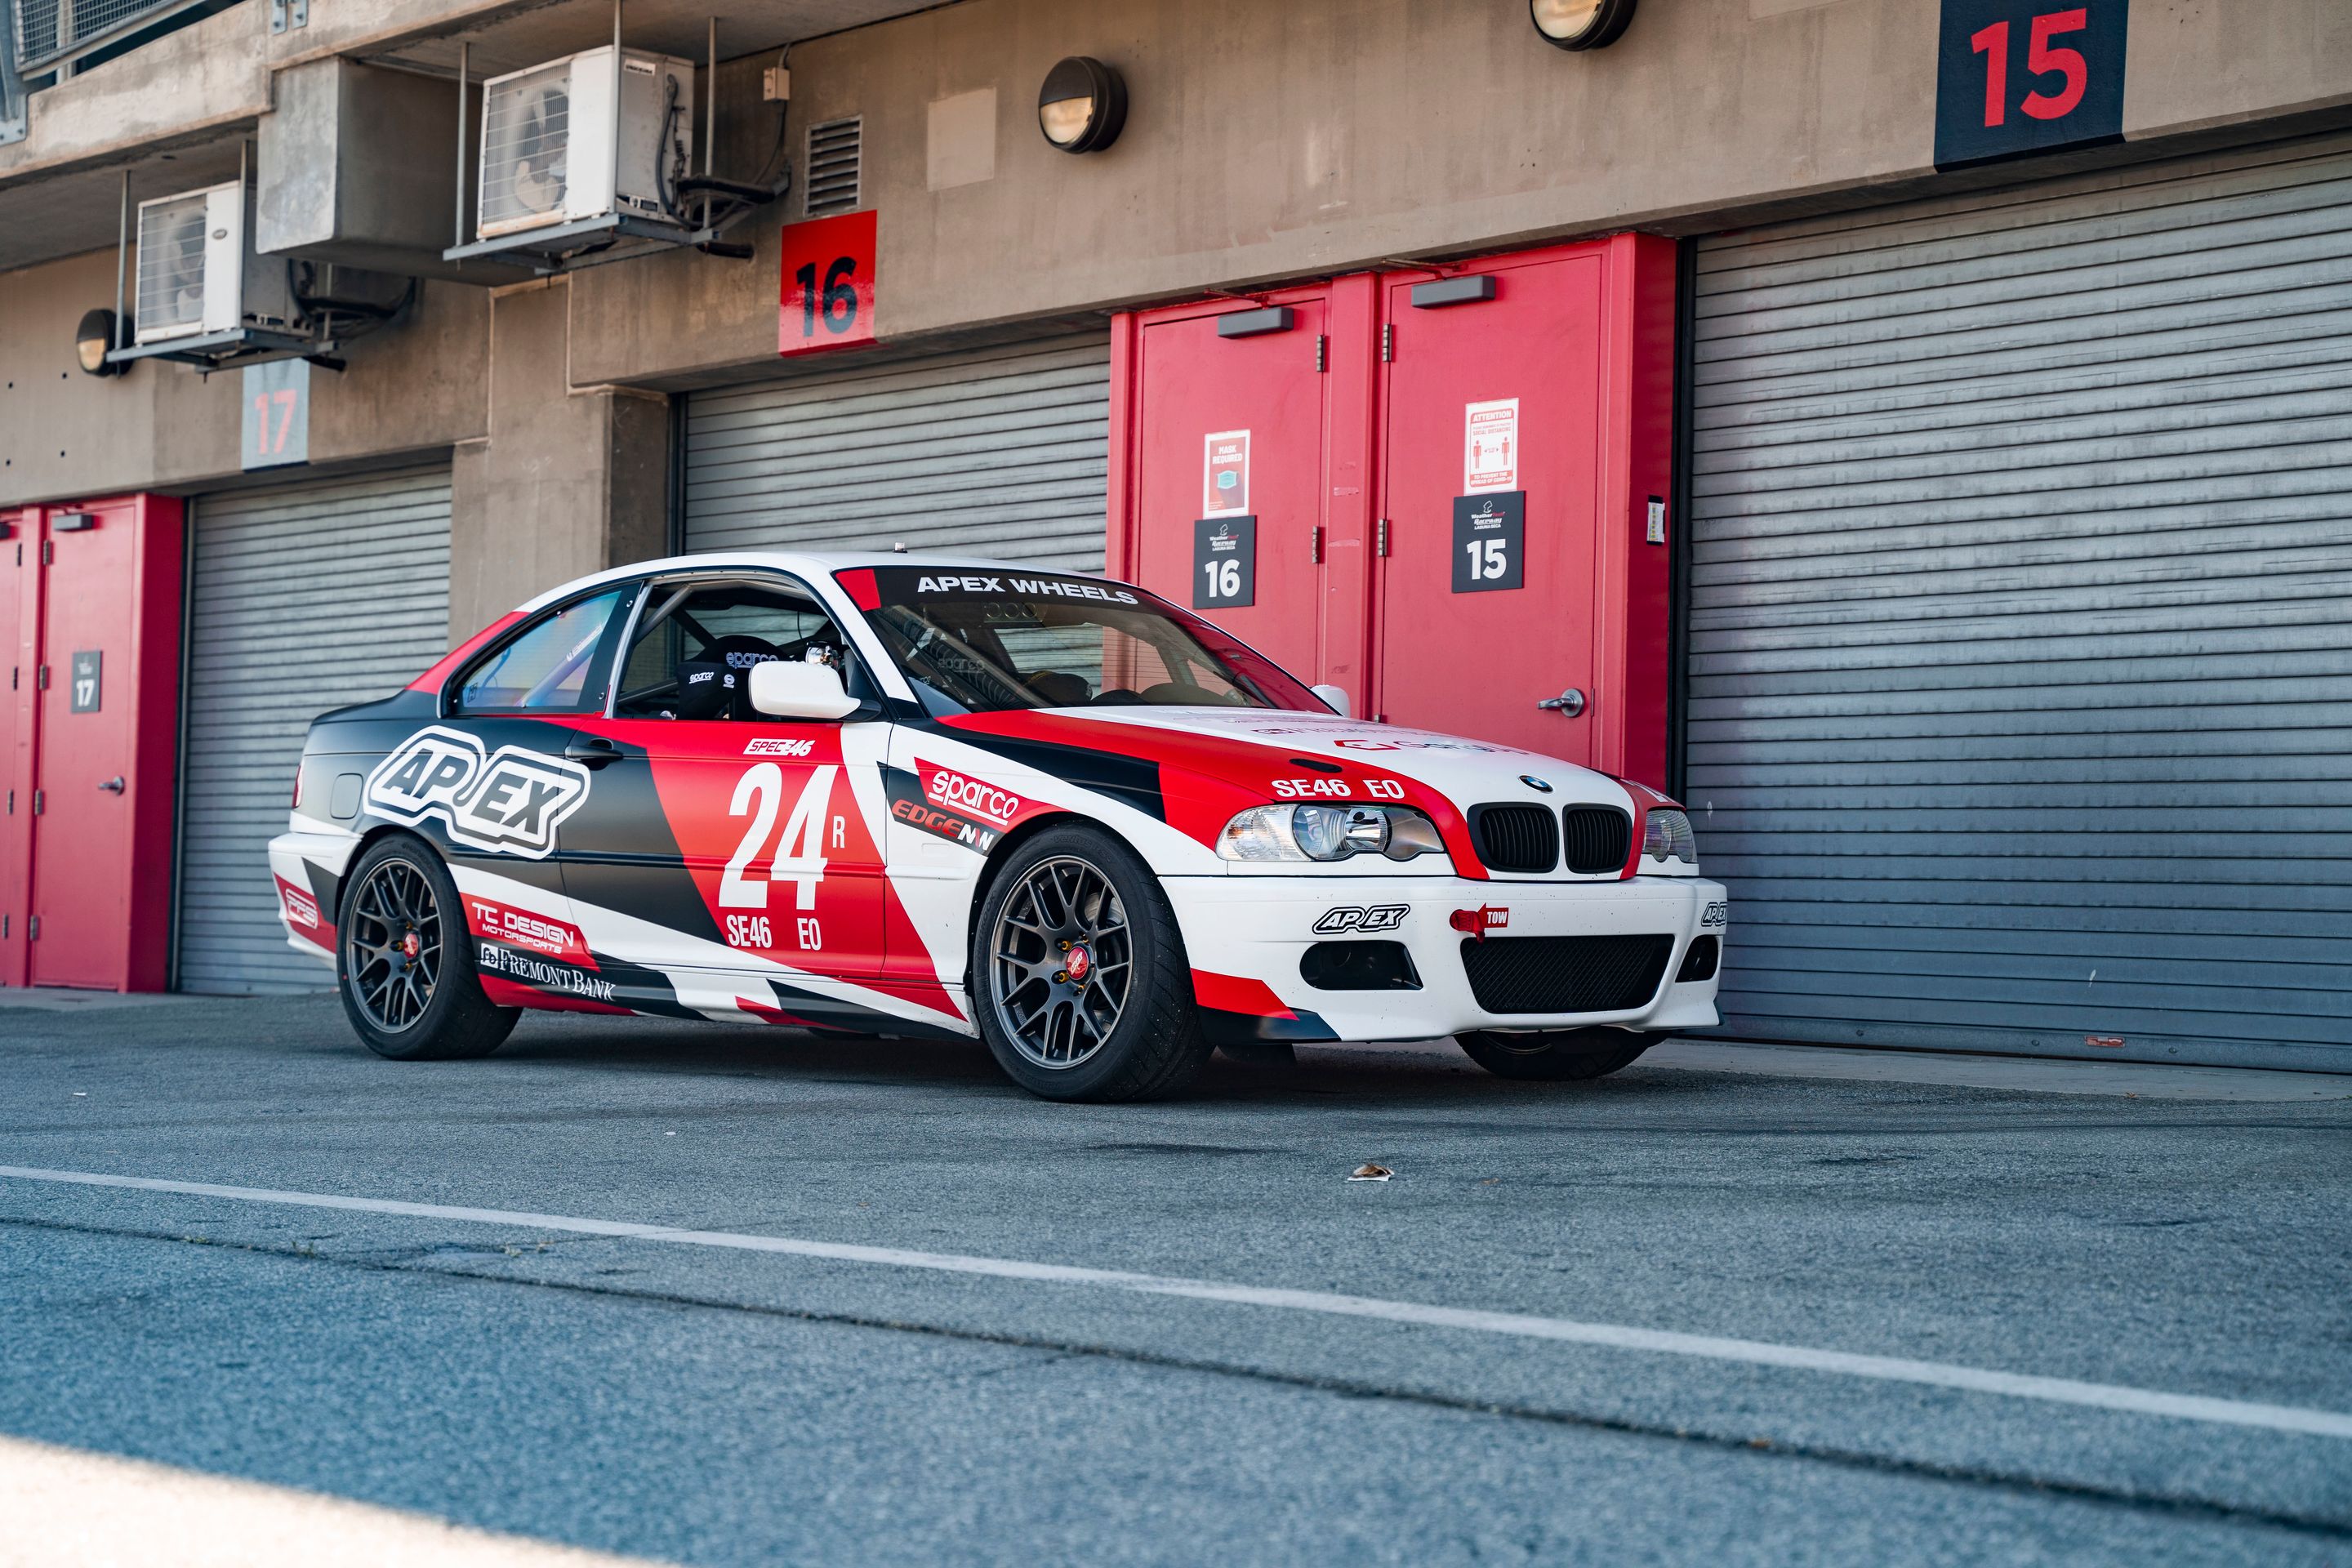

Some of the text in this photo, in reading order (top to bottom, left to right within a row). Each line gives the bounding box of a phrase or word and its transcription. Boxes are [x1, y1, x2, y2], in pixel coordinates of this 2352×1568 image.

[1971, 7, 2087, 127] 15
[796, 256, 858, 337] 16
[255, 388, 297, 455] 17
[1473, 410, 1512, 422] ATTENTION
[1212, 453, 1242, 464] REQUIRED
[1218, 444, 1236, 455] MASK
[1467, 538, 1507, 580] 15
[917, 577, 1138, 605] APEX WHEELS
[1205, 559, 1240, 598] 16
[76, 679, 95, 706] 17
[689, 672, 715, 683] sparco
[379, 746, 568, 837] APEX
[931, 771, 1019, 822] sparco
[1271, 779, 1352, 798] SE46
[719, 762, 839, 911] 24
[832, 816, 845, 849] R
[472, 902, 573, 947] TC DESIGN
[726, 915, 772, 948] SE46
[1319, 908, 1403, 929] APEX
[1487, 911, 1508, 924] TOW
[482, 924, 562, 954] MOTORSPORTS
[500, 948, 571, 989] FREMONT
[572, 969, 616, 1001] BANK
